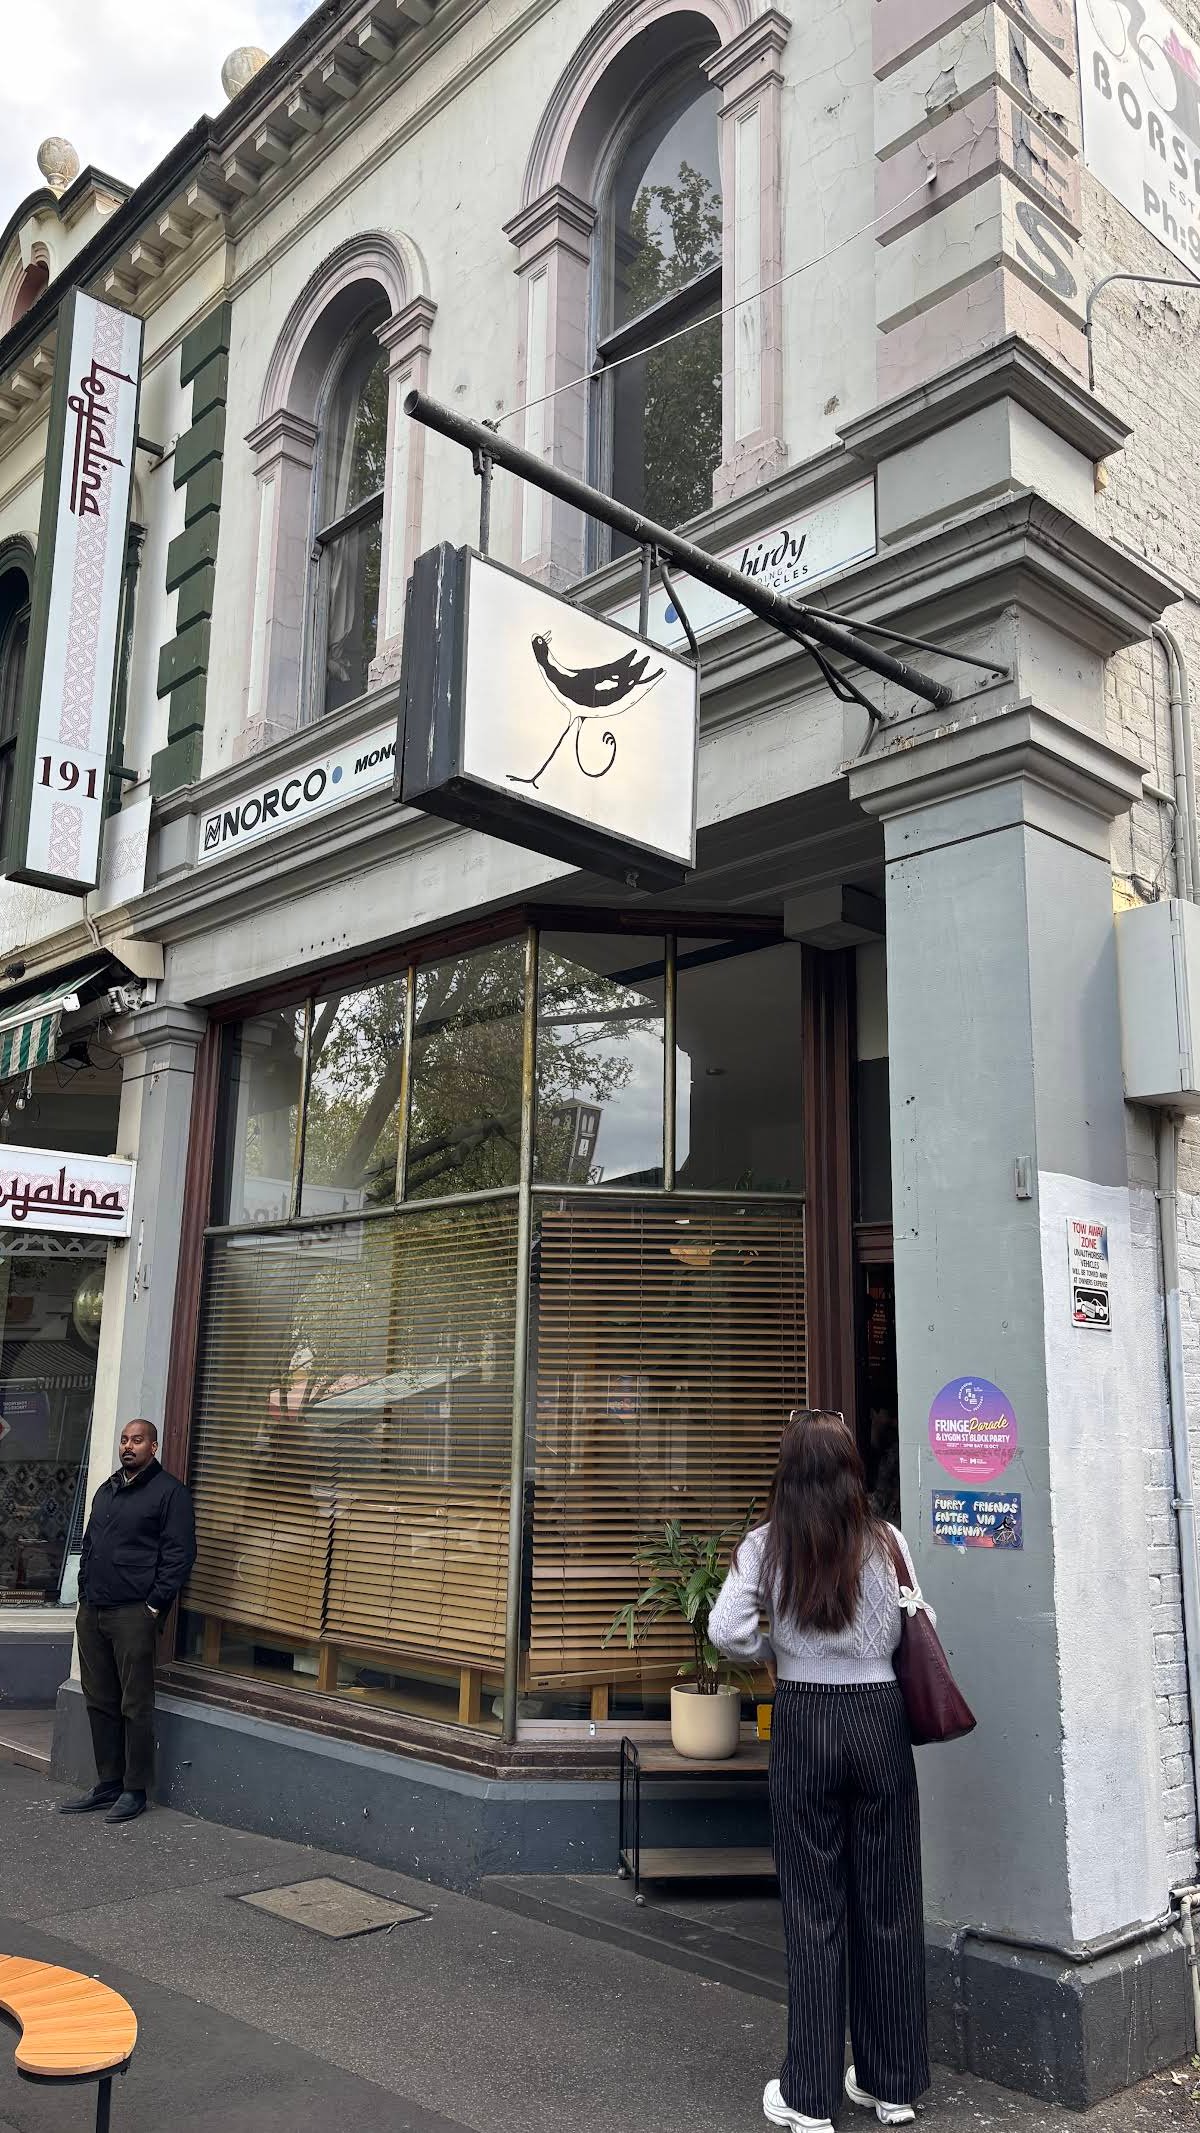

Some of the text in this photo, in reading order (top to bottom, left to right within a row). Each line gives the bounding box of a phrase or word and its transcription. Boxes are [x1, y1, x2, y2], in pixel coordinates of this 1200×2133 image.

[1169, 180, 1200, 220] EST
[68, 358, 137, 517] Leyalina
[766, 565, 808, 588] CLES
[37, 756, 98, 800] 191
[222, 768, 326, 840] NORCO
[1072, 1222, 1104, 1237] TOW AWAY
[1081, 1236, 1097, 1249] ZONE
[1073, 1248, 1105, 1260] UNAUTHORISED
[1081, 1259, 1099, 1269] VEHICLES
[935, 1413, 1009, 1434] FRINGE Parade
[935, 1433, 1010, 1443] & LYGON ST BLOCK PARTY
[934, 1498, 1018, 1514] FURRY FRIENDS
[935, 1511, 996, 1525] ENTER VIA
[935, 1524, 987, 1537] LANEWAY
